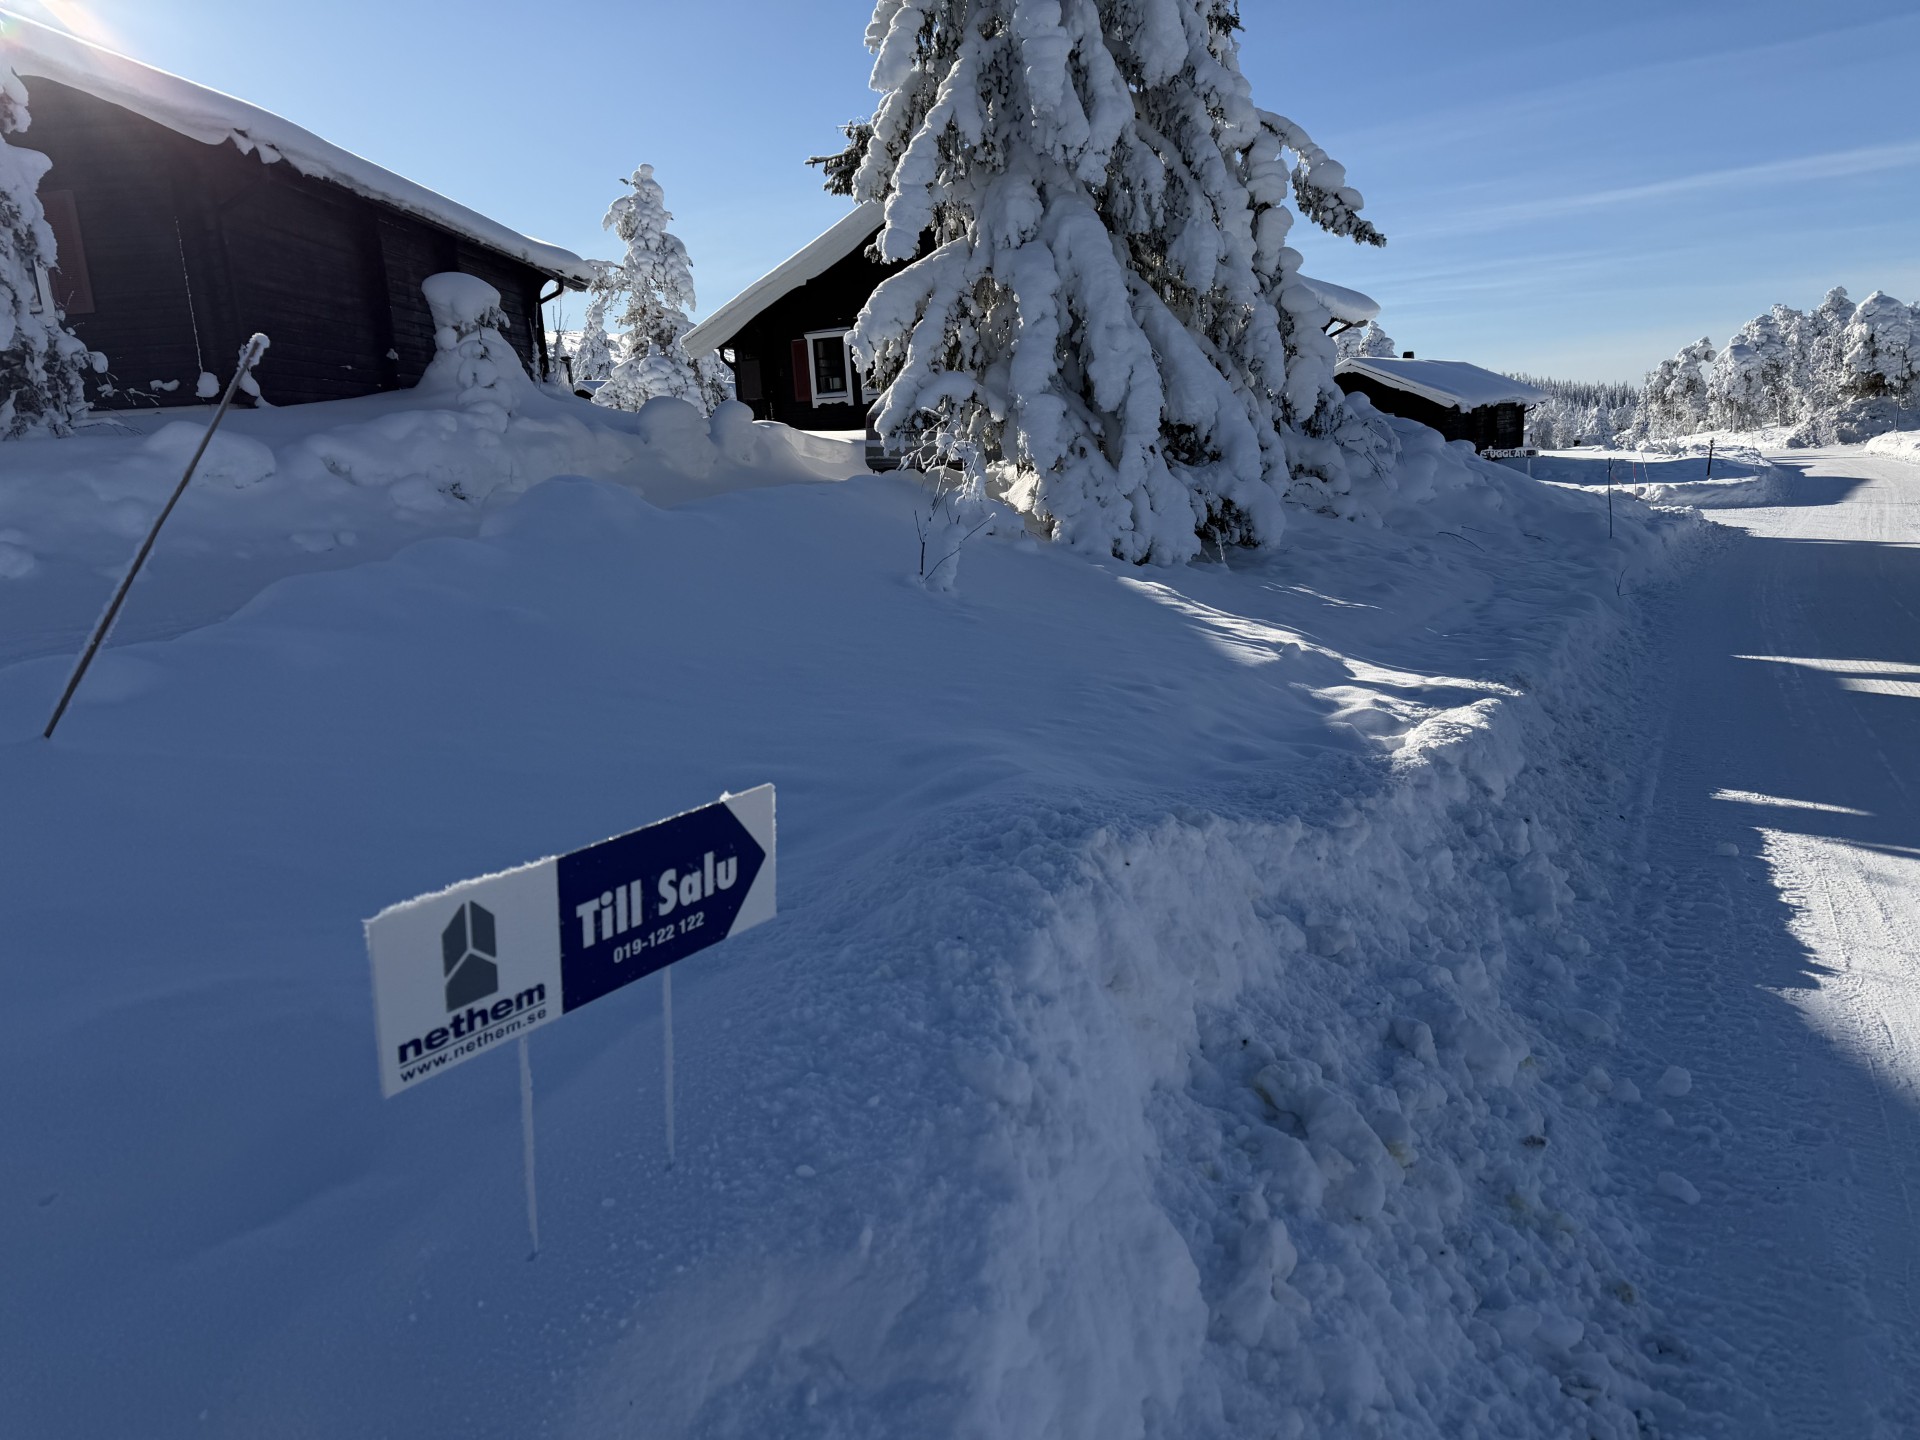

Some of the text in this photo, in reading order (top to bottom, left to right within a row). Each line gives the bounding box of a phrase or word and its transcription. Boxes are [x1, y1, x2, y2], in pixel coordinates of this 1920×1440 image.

[1489, 449, 1527, 459] UGGLAN
[576, 851, 738, 949] Till Salu
[613, 912, 705, 964] 019-122 122
[398, 982, 546, 1064] nethem
[400, 1008, 547, 1082] www.nethem.se
